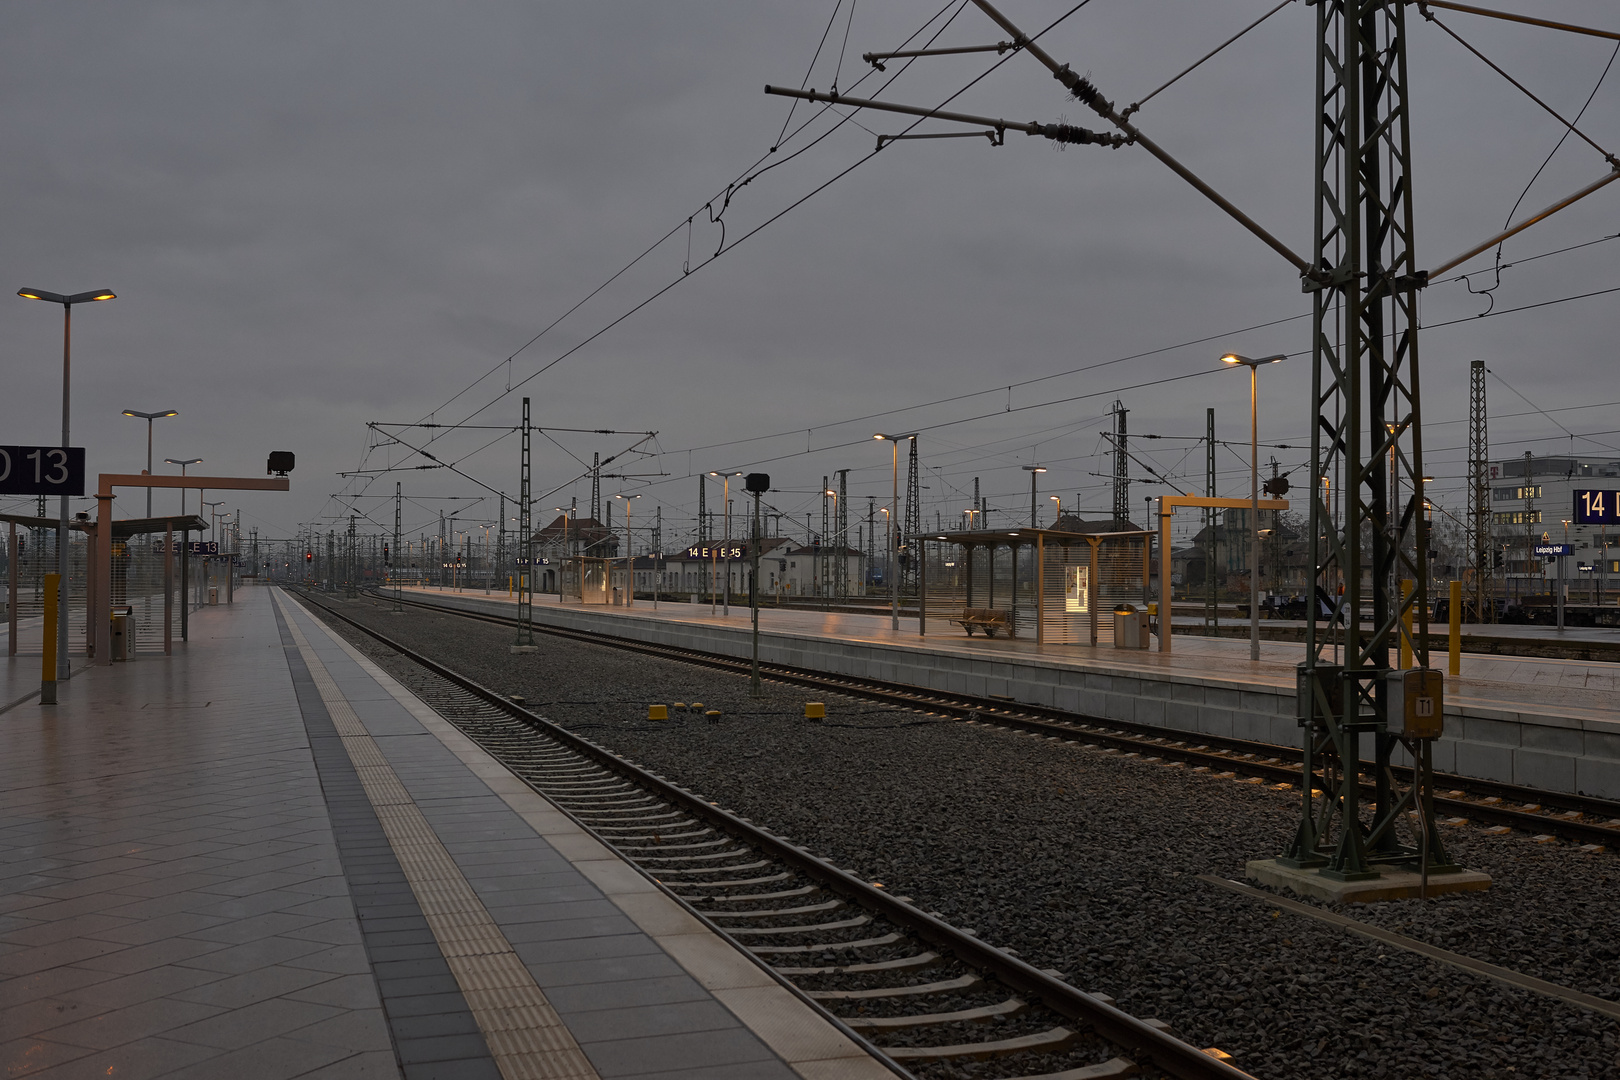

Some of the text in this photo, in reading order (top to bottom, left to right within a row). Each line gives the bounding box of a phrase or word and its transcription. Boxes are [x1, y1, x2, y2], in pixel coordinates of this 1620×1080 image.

[26, 449, 69, 485] 13
[1490, 467, 1499, 479] T
[1582, 491, 1605, 517] 14
[194, 543, 200, 552] E
[206, 543, 217, 552] 13
[688, 548, 698, 557] 14
[702, 548, 708, 557] E
[730, 548, 741, 557] 15
[1419, 699, 1430, 714] T1
